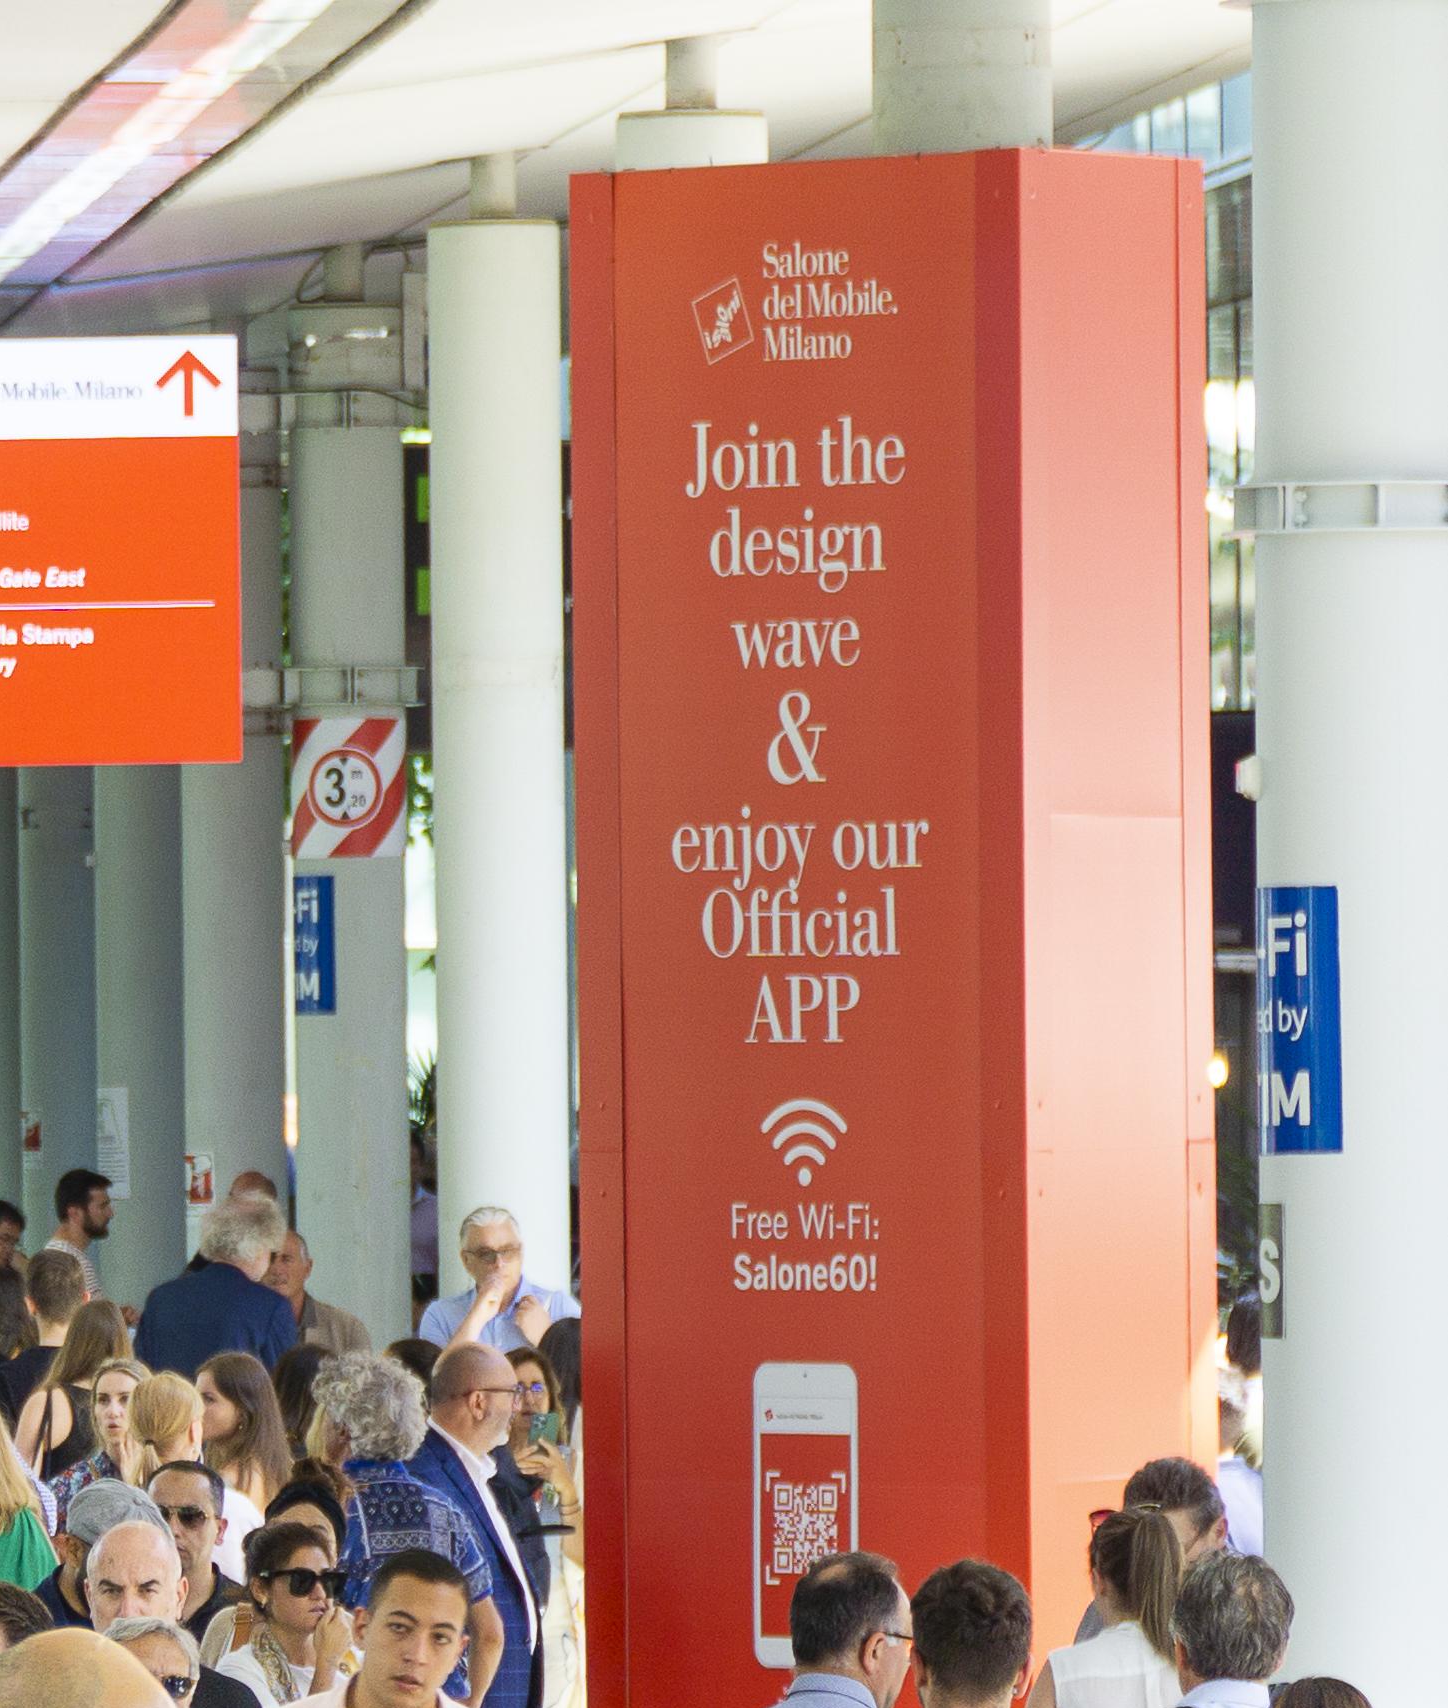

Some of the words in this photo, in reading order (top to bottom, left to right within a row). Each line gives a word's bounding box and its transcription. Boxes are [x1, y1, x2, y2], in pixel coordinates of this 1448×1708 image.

[762, 240, 850, 280] Salone
[763, 283, 803, 321] del
[806, 279, 899, 319] Mobile.
[763, 324, 852, 362] Milano
[75, 379, 143, 400] Milano
[685, 421, 801, 498] Join
[817, 415, 906, 487] the
[709, 506, 886, 593] design
[46, 565, 85, 587] East
[22, 625, 94, 648] Stampa
[731, 616, 861, 671] wave
[766, 690, 827, 785] &
[325, 767, 346, 808] 3
[671, 805, 815, 890] enjoy
[832, 816, 930, 872] our
[702, 886, 901, 959] Official
[744, 974, 862, 1046] APP
[1278, 999, 1308, 1042] by
[730, 1203, 789, 1241] Free
[799, 1200, 880, 1240] Wi-Fi:
[733, 1255, 878, 1294] Salone60!
